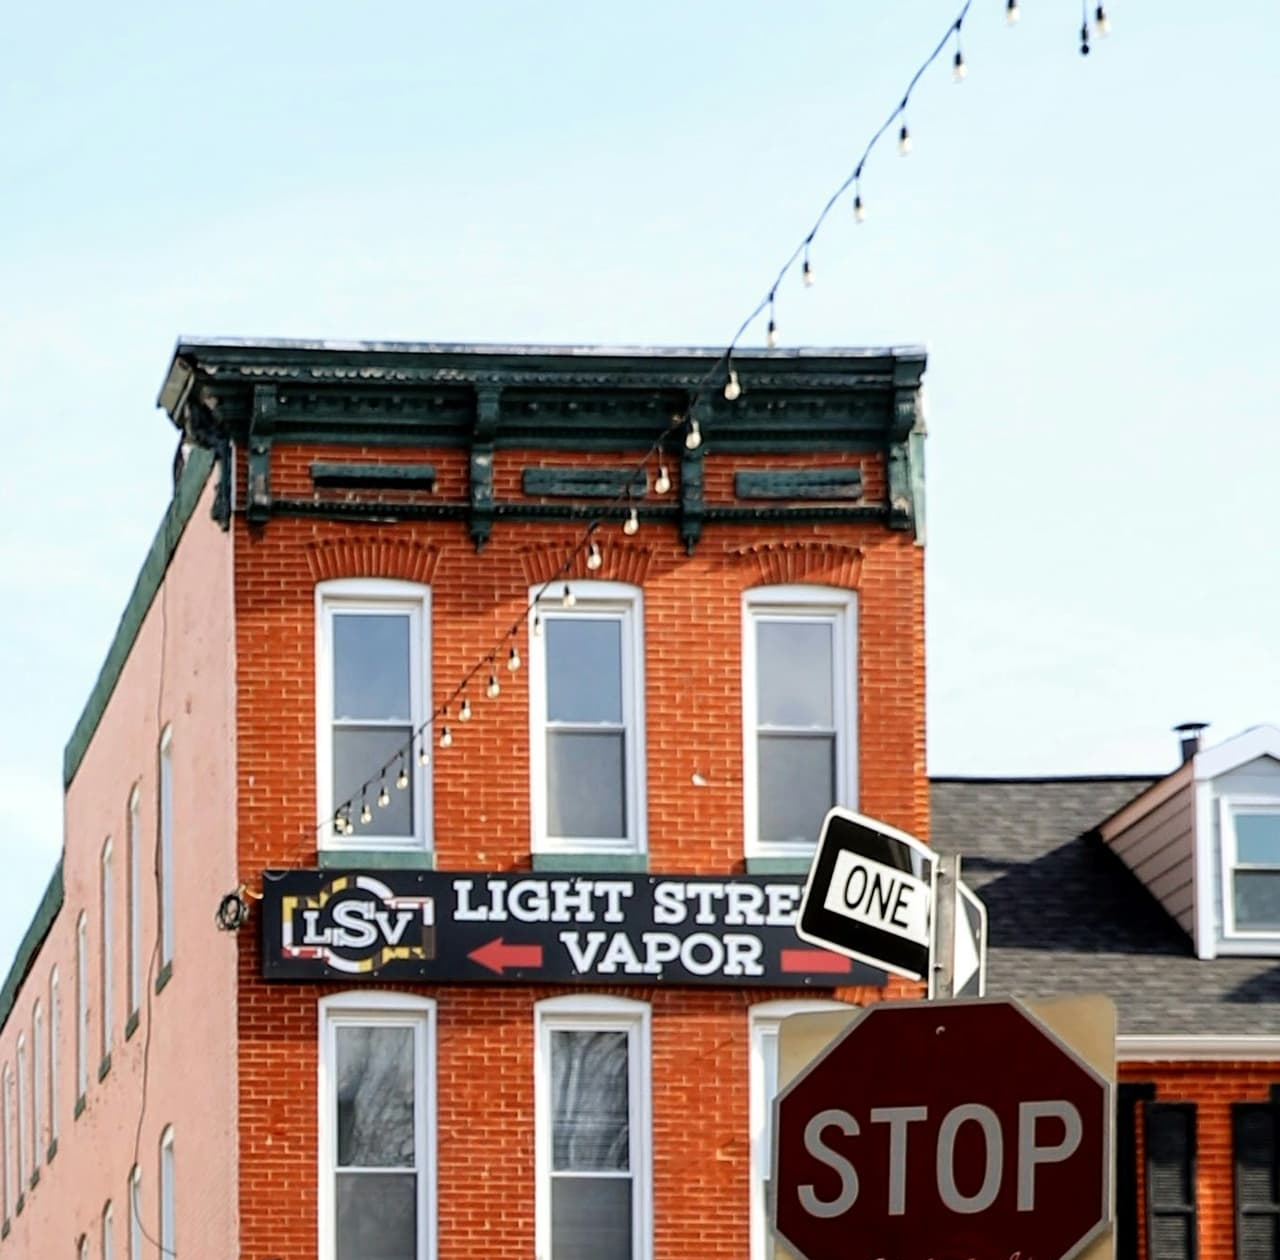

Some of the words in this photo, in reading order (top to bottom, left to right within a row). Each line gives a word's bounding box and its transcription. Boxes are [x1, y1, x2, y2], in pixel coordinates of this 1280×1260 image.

[453, 880, 632, 923] LIGHT
[654, 885, 804, 926] STRE
[843, 865, 914, 929] ONE
[303, 899, 413, 948] LSV
[560, 932, 764, 976] VAPOR
[797, 1100, 1083, 1218] STOP
